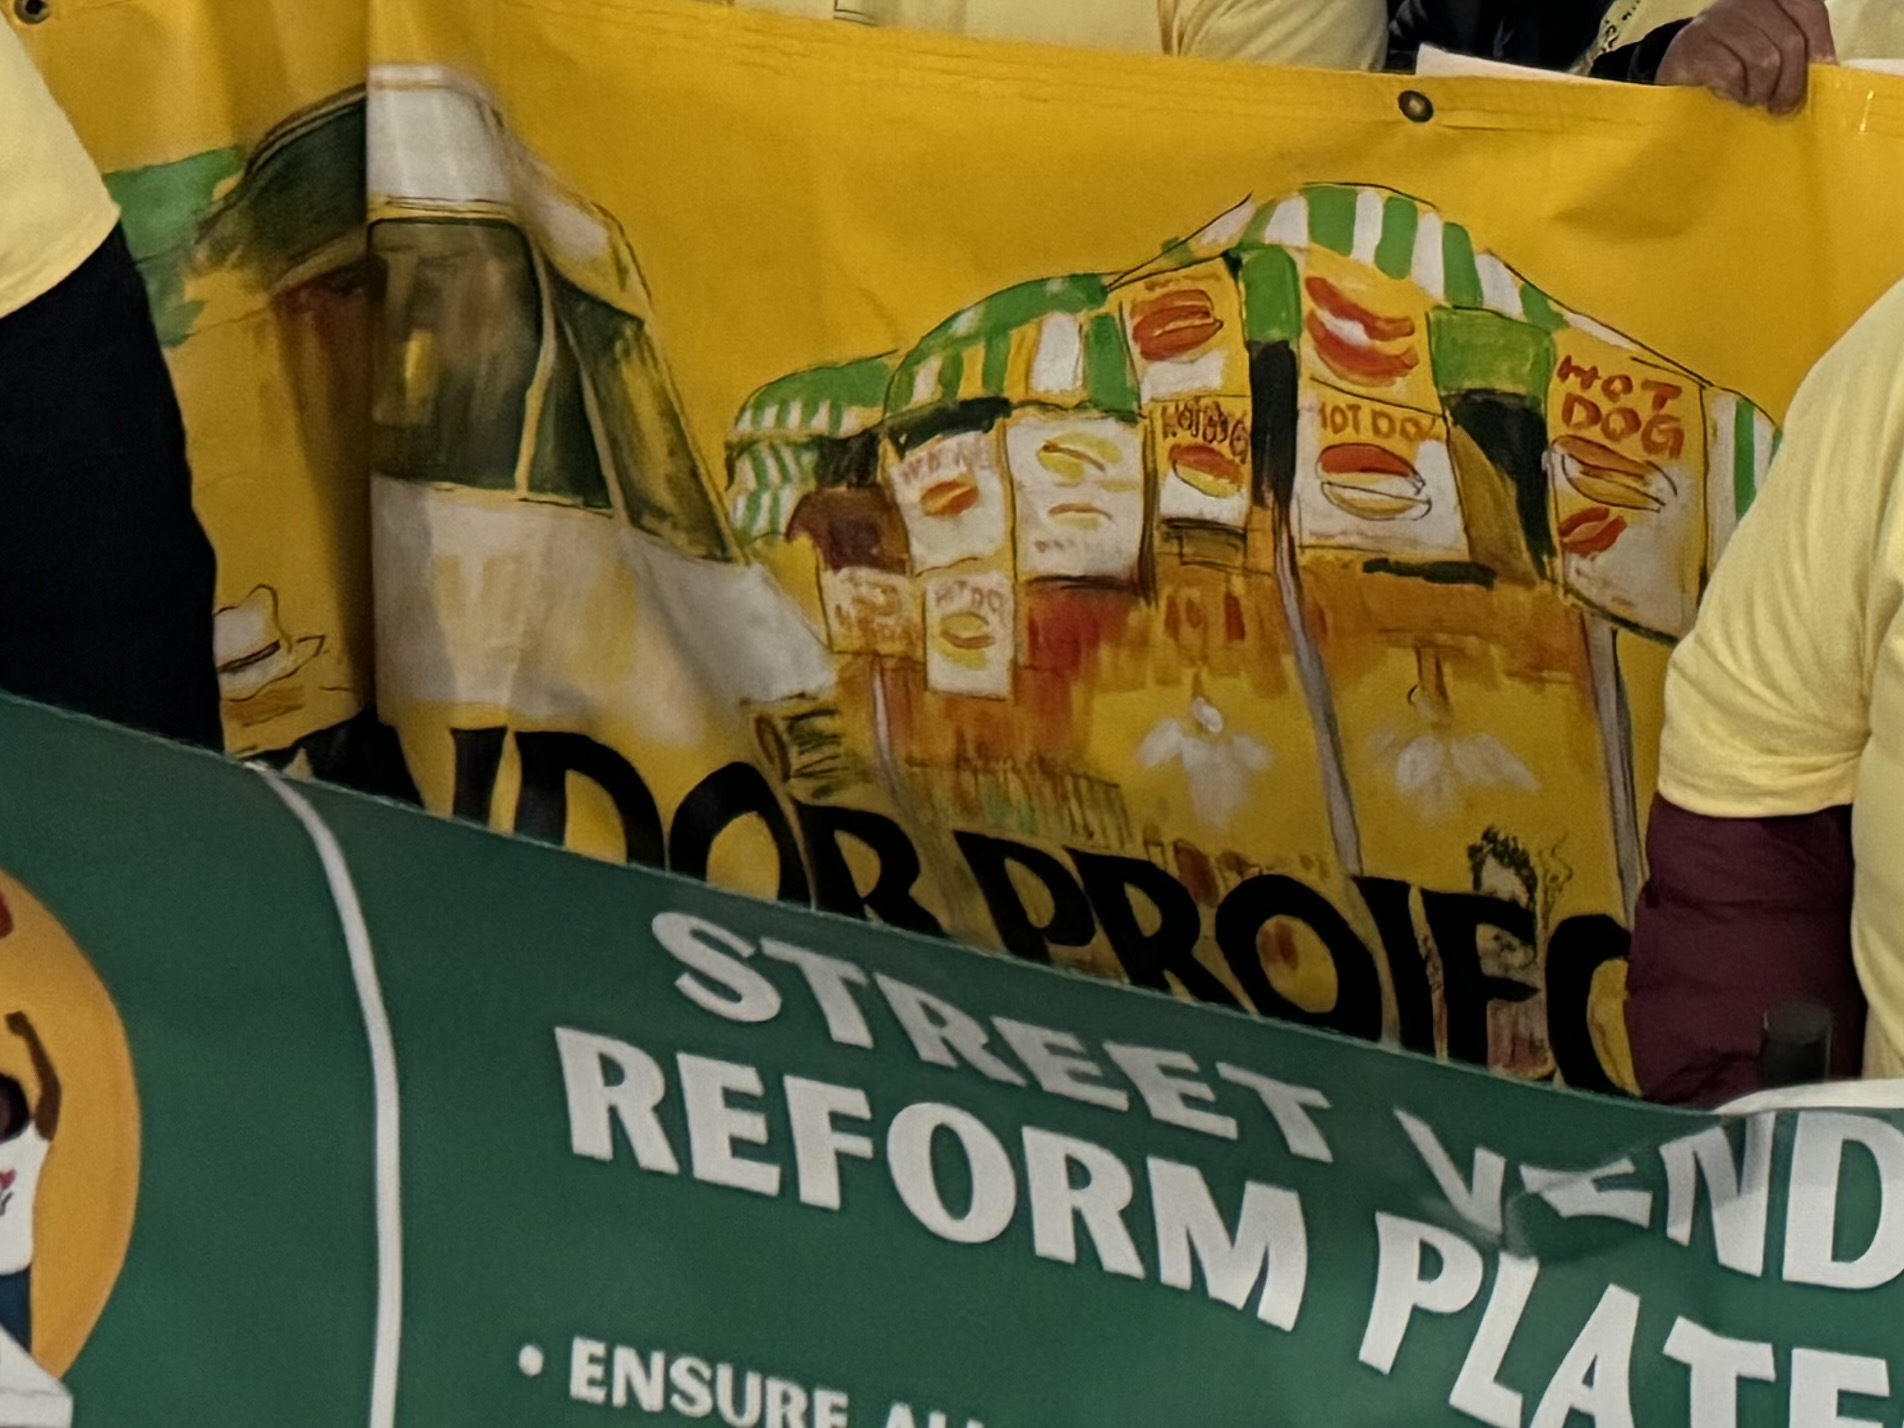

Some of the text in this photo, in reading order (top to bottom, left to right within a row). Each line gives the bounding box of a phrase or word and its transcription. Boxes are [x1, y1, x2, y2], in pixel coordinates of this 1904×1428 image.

[1556, 355, 1683, 413] HOT
[1562, 390, 1685, 459] DOG
[649, 909, 1332, 1164] STREET
[954, 826, 1633, 1098] PROJEC
[553, 1025, 1307, 1332] REFORM
[569, 1336, 849, 1428] ENSURE
